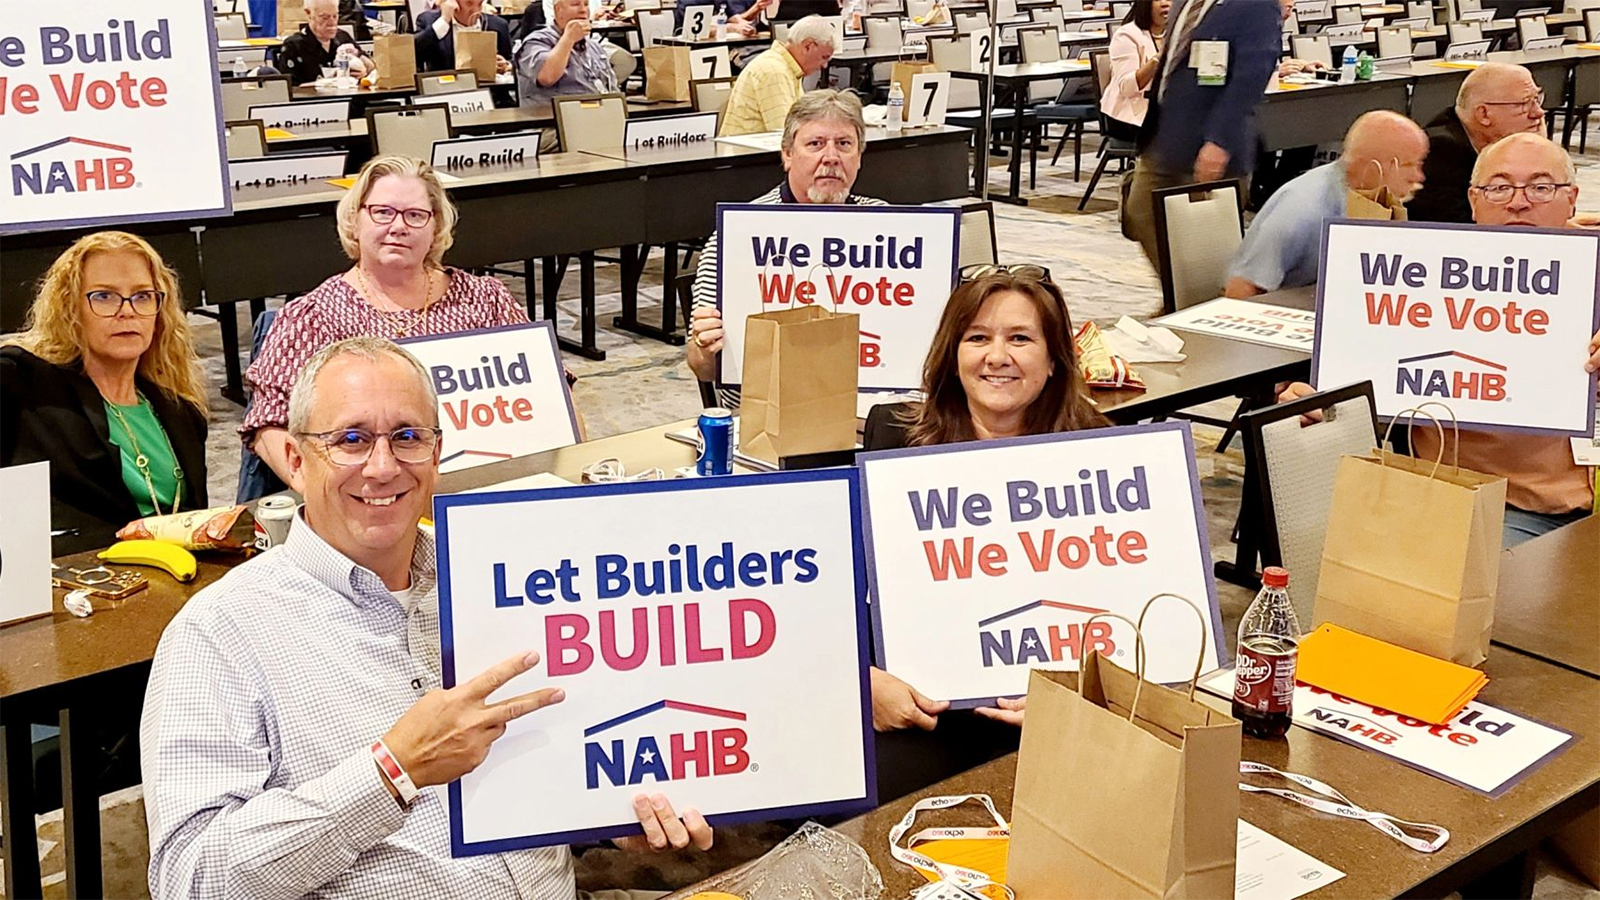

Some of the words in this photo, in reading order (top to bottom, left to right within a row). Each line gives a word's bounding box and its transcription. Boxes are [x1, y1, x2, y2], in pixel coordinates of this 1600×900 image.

[0, 37, 25, 67] e
[40, 19, 172, 66] Build
[690, 12, 703, 35] 3
[702, 56, 718, 78] 7
[979, 35, 990, 63] 2
[0, 77, 40, 116] e
[50, 71, 168, 112] Vote
[923, 82, 938, 117] 7
[12, 157, 135, 195] NAHB
[752, 236, 811, 267] We
[822, 235, 923, 269] Build
[758, 273, 816, 304] We
[826, 275, 915, 306] Vote
[1360, 252, 1427, 288] We
[1440, 256, 1561, 295] Build
[1189, 318, 1280, 337] Build
[1365, 292, 1432, 328] We
[1444, 297, 1549, 335] Vote
[430, 352, 532, 396] Build
[1396, 367, 1507, 402] NAHB
[442, 395, 534, 431] Vote
[908, 487, 992, 531] We
[1006, 466, 1151, 522] Build
[922, 536, 1008, 582] We
[1017, 525, 1148, 572] Vote
[493, 559, 581, 608] Let
[595, 542, 819, 600] Builders
[544, 598, 777, 678] BUILD
[979, 621, 1116, 668] NAHB
[1304, 708, 1398, 745] NAHB
[584, 727, 750, 790] NAHB
